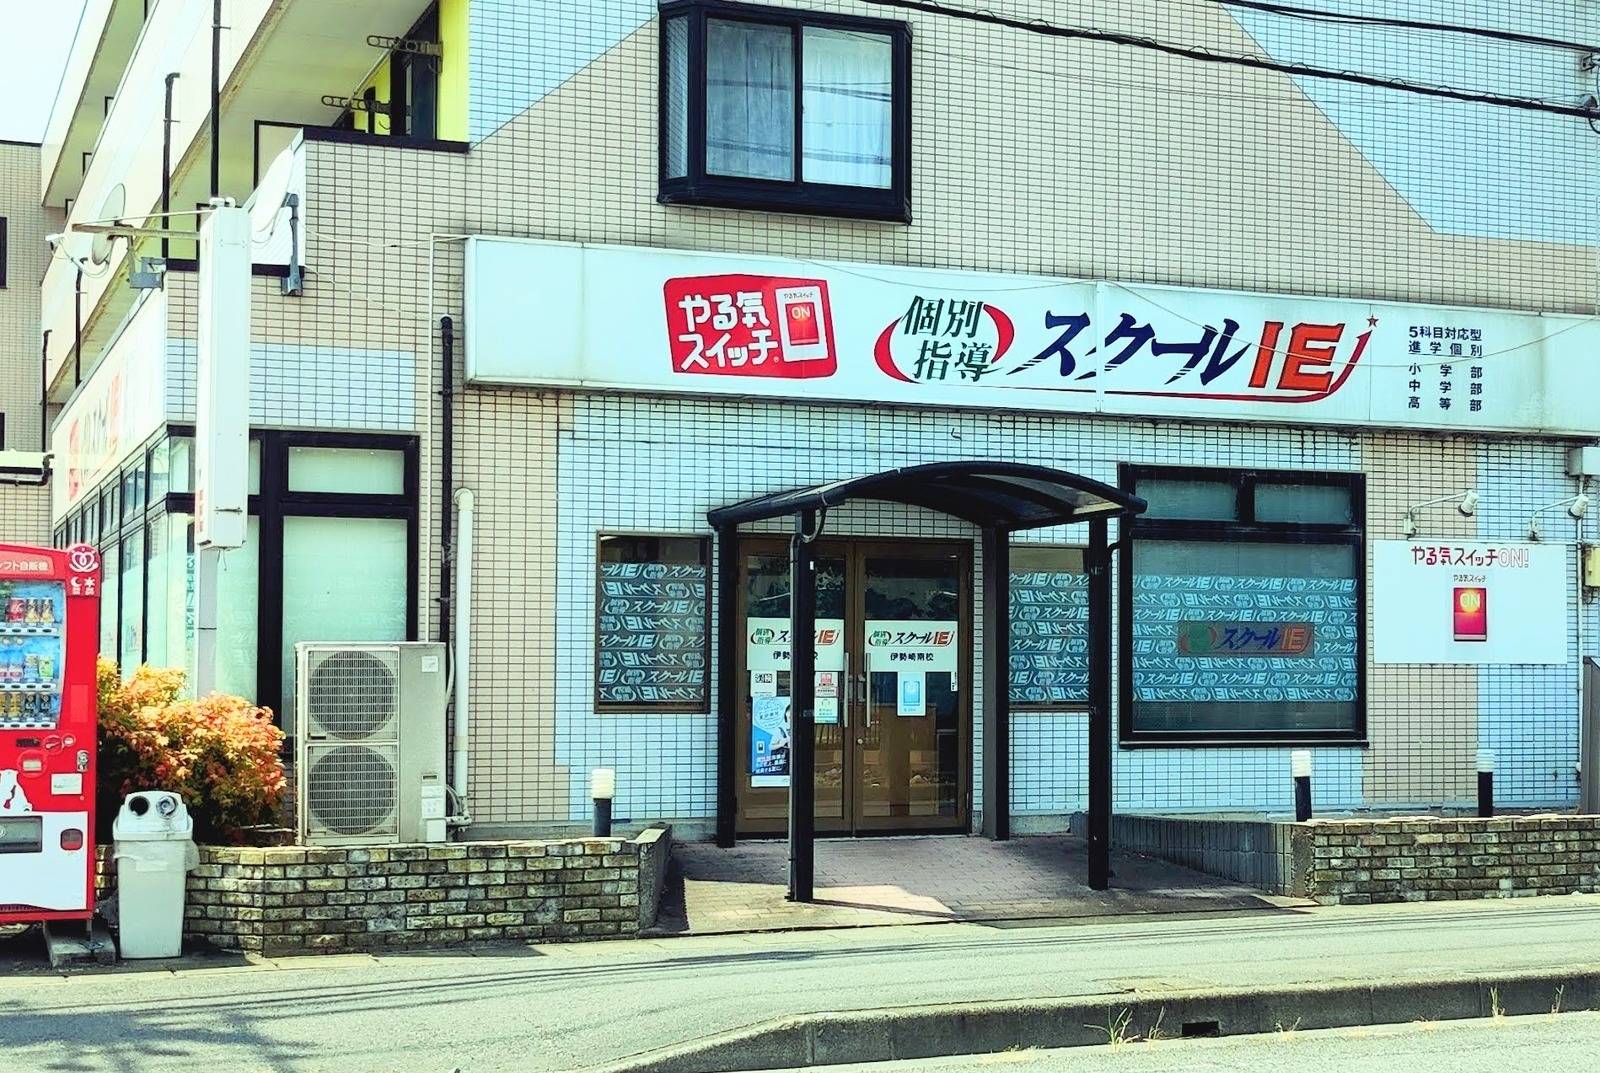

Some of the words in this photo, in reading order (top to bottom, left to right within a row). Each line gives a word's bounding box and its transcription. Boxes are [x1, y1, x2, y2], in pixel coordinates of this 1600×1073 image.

[678, 291, 771, 332] やる気
[791, 305, 811, 319] ON
[902, 295, 984, 339] 個別
[1409, 326, 1482, 341] 5科目対応型
[680, 329, 778, 371] スイッチ
[1408, 341, 1482, 356] 進学個別
[913, 340, 1001, 382] 指導
[1408, 363, 1483, 379] 小学部
[1408, 379, 1483, 395] 中学部
[1408, 396, 1482, 412] 高等部
[1460, 593, 1480, 608] ON
[891, 631, 951, 645] スクールIE
